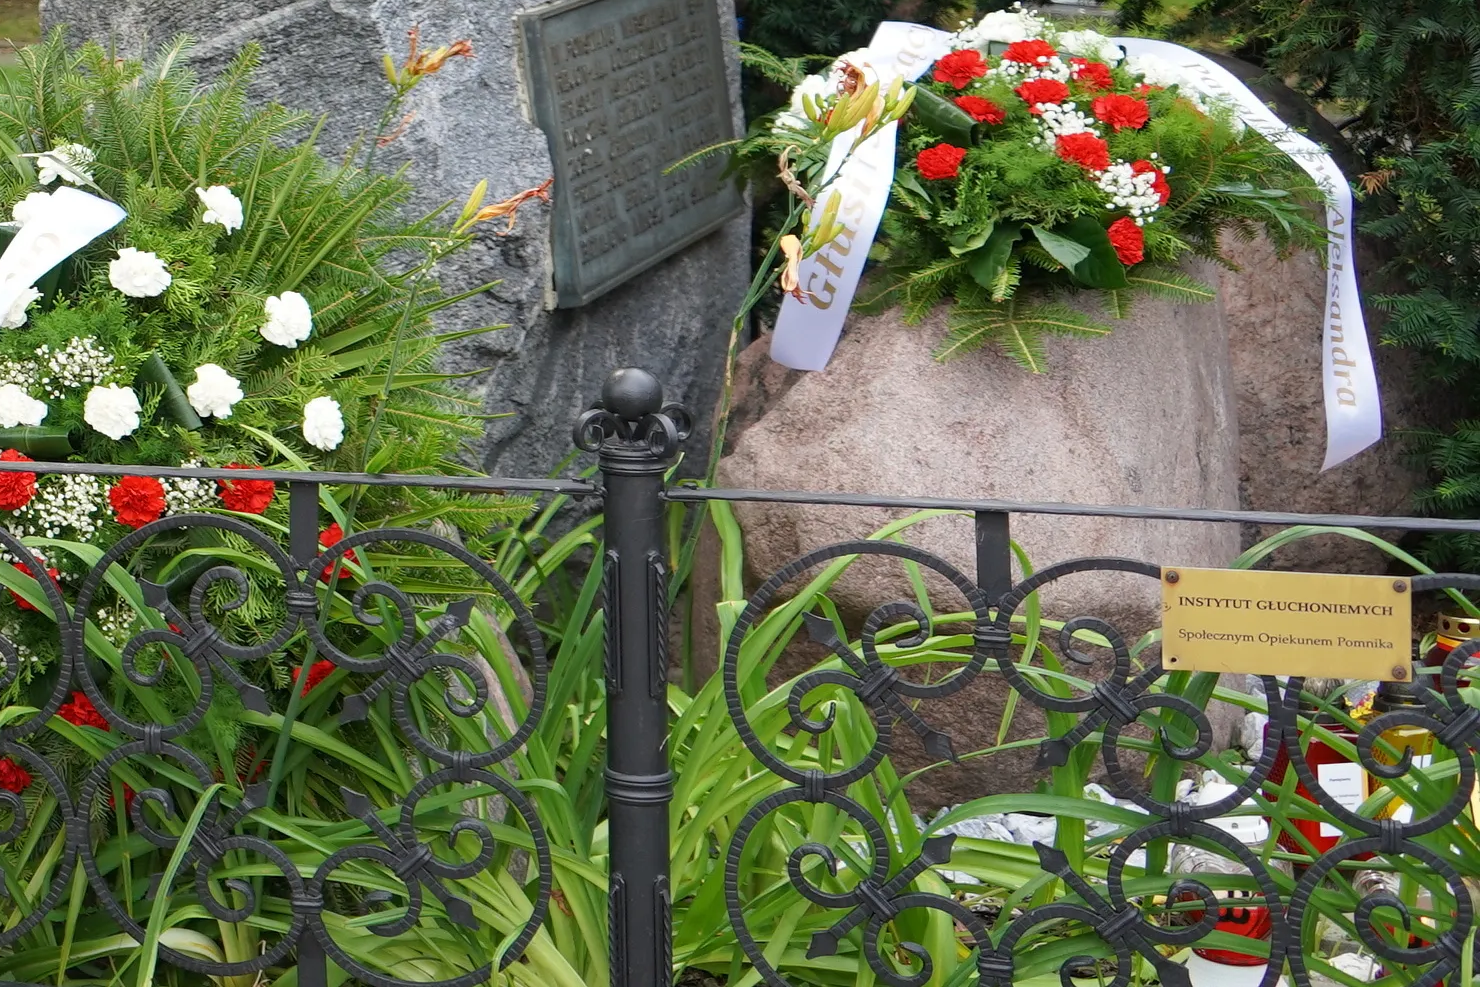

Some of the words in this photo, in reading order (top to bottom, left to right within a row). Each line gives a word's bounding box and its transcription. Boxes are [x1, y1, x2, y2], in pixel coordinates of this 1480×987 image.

[1328, 205, 1357, 407] Aleksandra
[1178, 596, 1253, 609] INSTYTUT
[1256, 600, 1393, 616] GŁUCHONIEMYCH
[1178, 628, 1254, 646] Społecznym
[1258, 632, 1333, 647] Opiekunem
[1337, 637, 1394, 649] Pomnika
